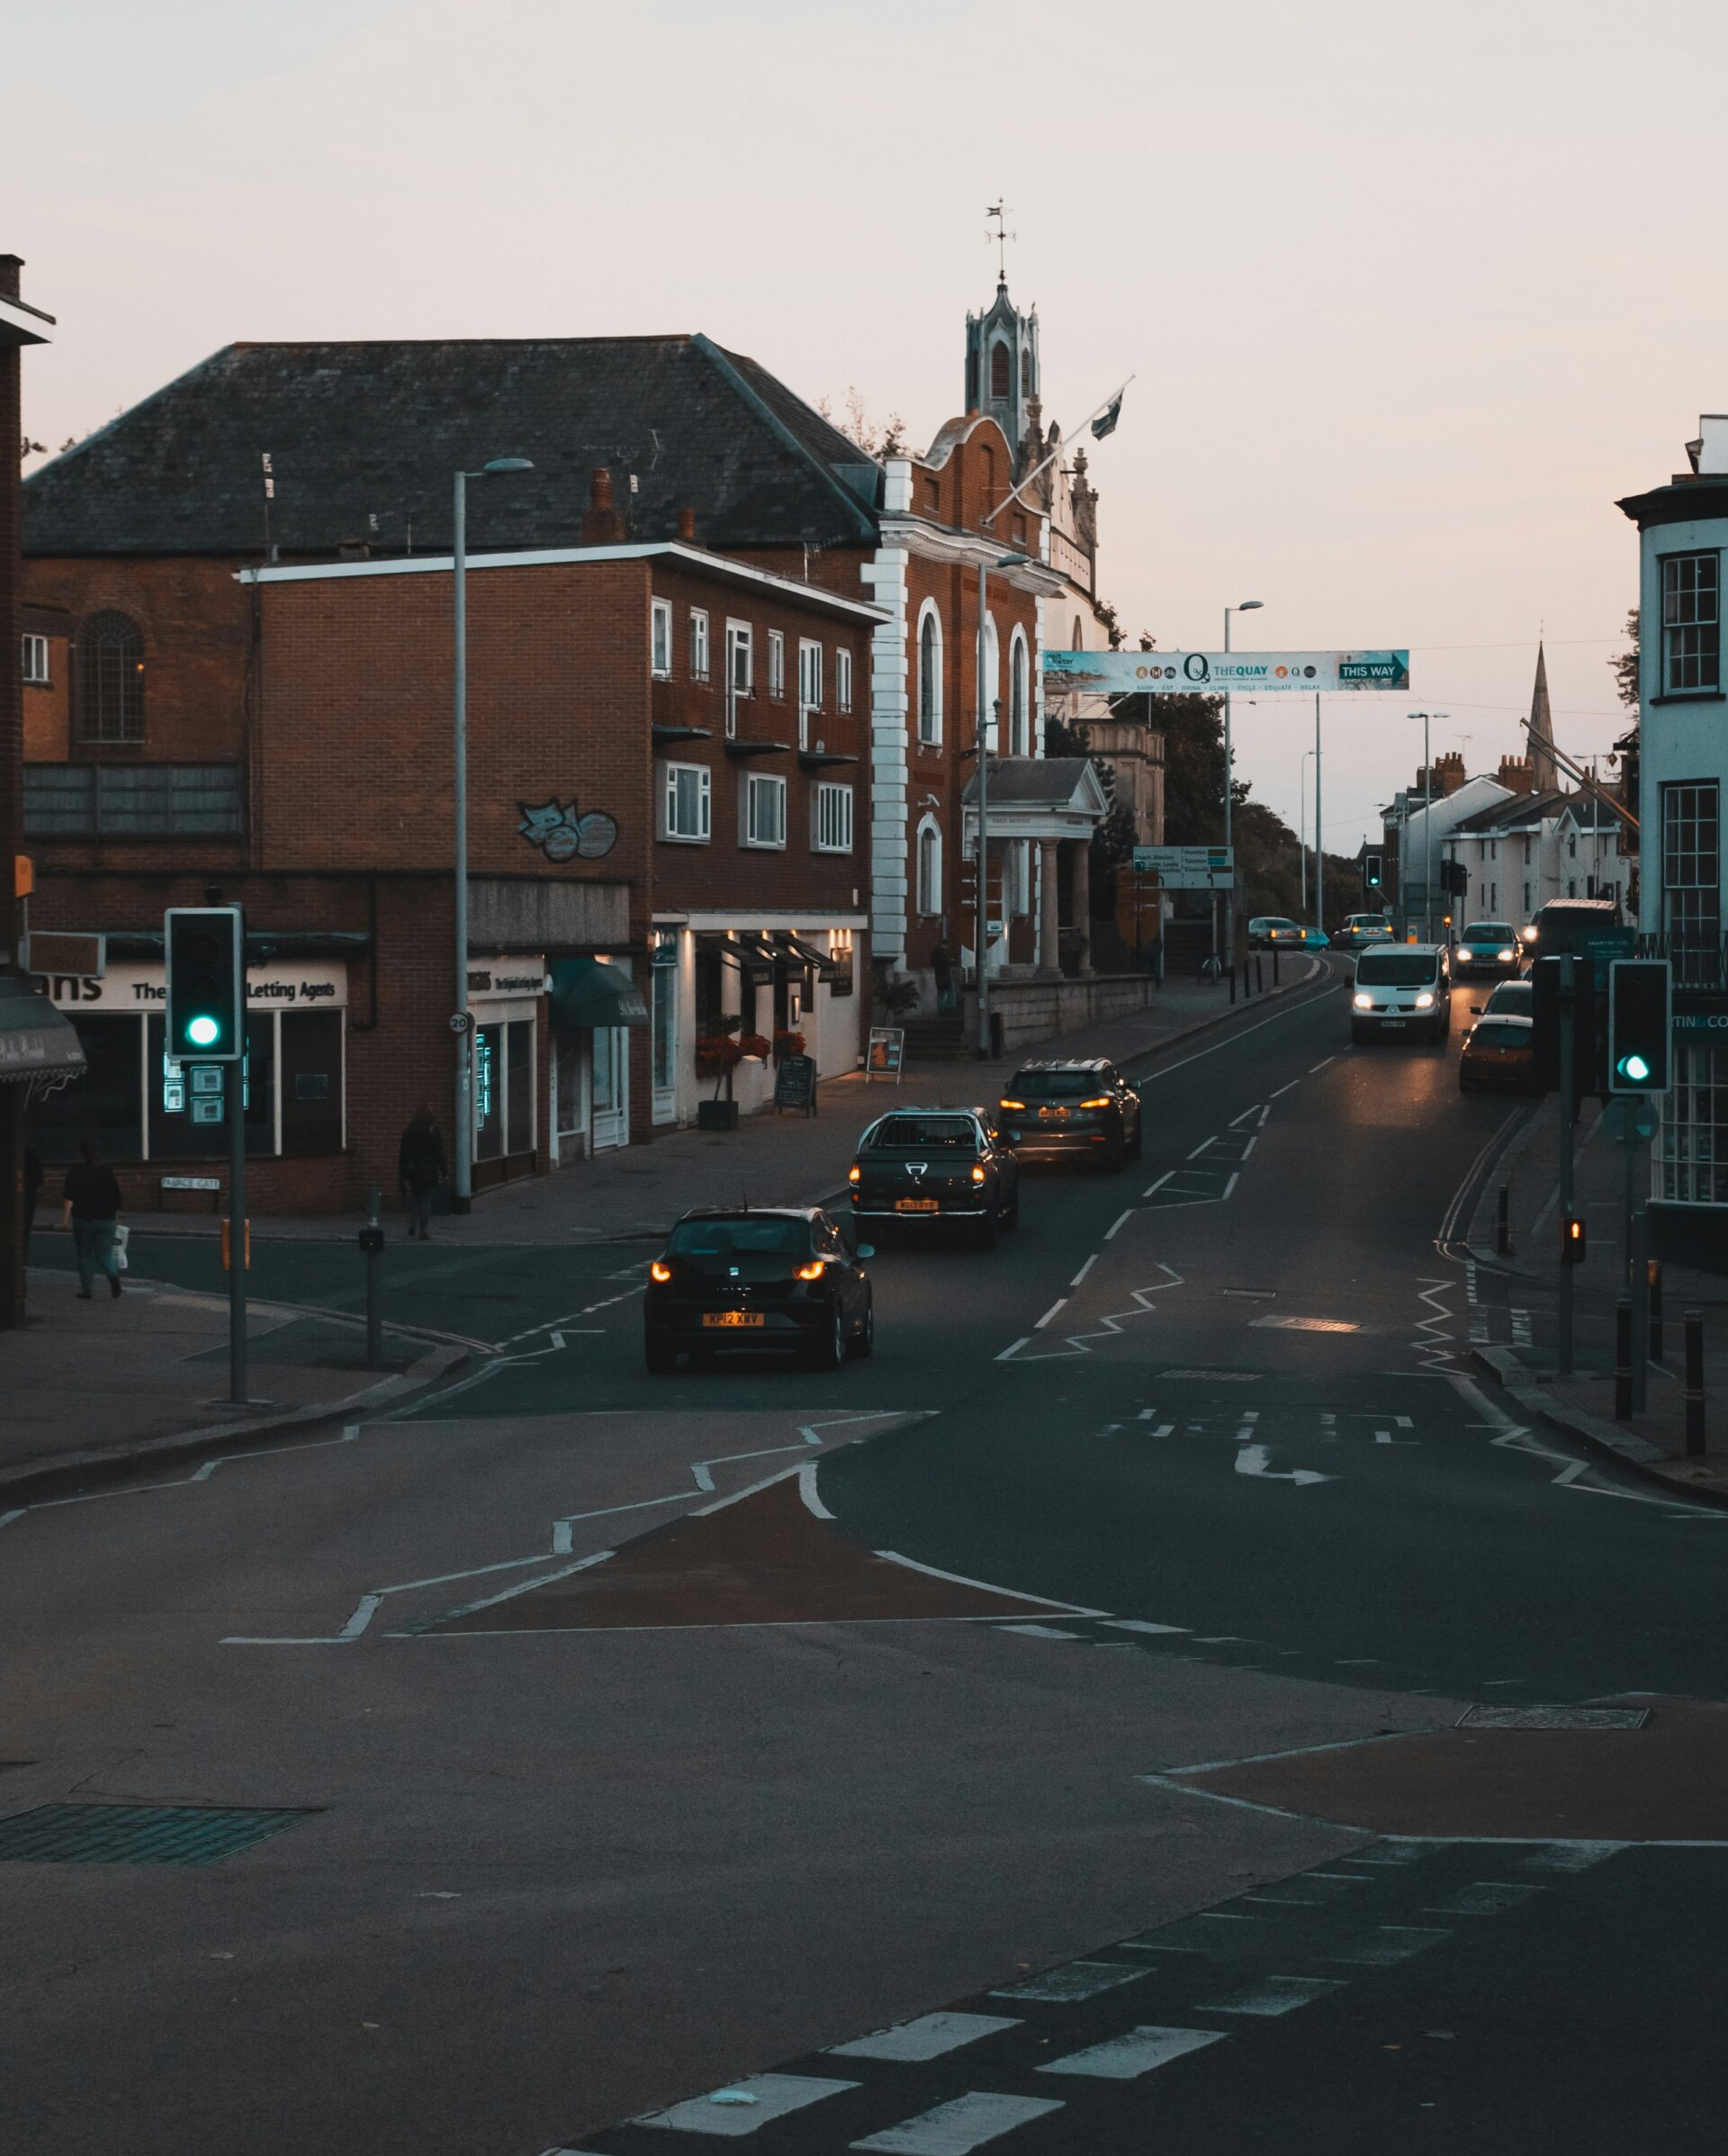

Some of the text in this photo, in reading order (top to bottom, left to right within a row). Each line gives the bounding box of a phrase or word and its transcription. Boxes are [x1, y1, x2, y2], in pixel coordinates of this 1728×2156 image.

[1342, 666, 1396, 677] THIS WAY
[132, 981, 336, 1001] The Letting Agents
[451, 1018, 466, 1028] 20
[1707, 1015, 1728, 1027] CO
